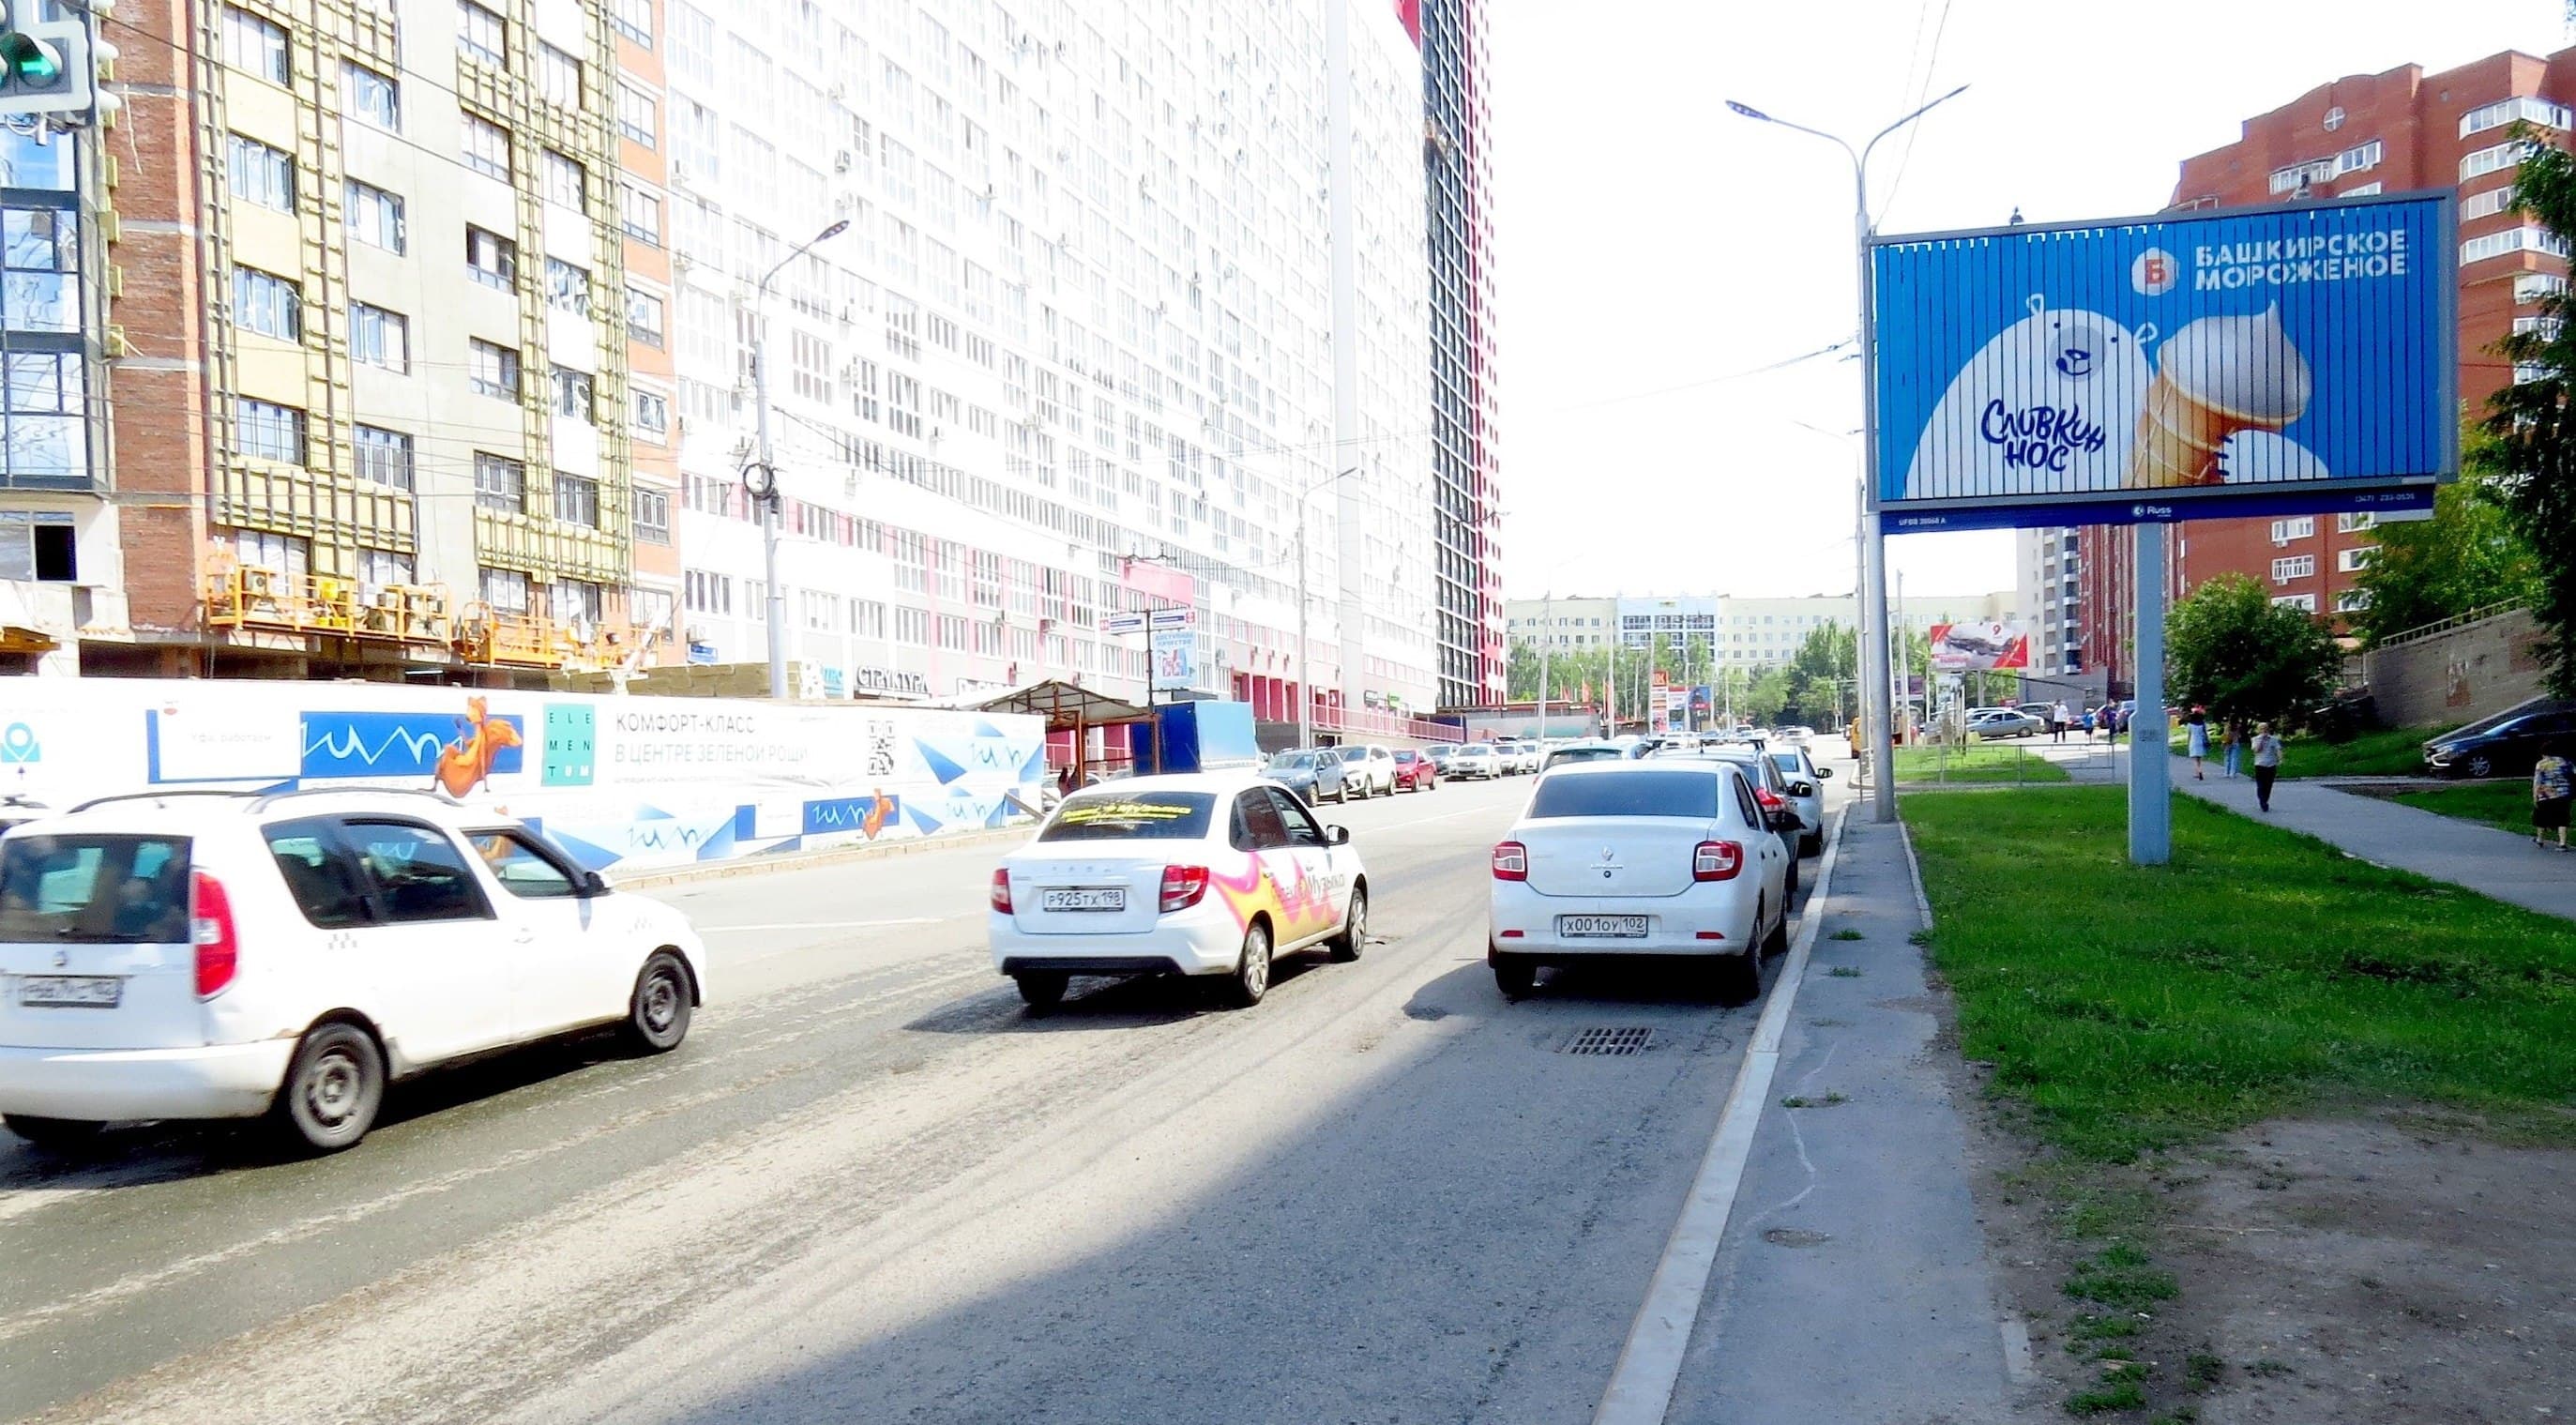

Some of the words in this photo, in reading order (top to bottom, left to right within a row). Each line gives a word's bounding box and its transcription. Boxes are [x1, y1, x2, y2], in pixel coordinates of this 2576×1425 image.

[2195, 229, 2409, 267] БАШКИРСКОЕ
[2144, 259, 2165, 284] Б
[2194, 252, 2409, 291] МОРОЖЕНОЕ
[2147, 506, 2173, 515] Russ
[616, 712, 755, 734] КОМФОРТ-КЛАСС
[615, 744, 625, 762] В
[629, 744, 691, 766] ЦЕНТРЕ
[1101, 891, 1121, 902] 198
[1623, 917, 1644, 929] 102
